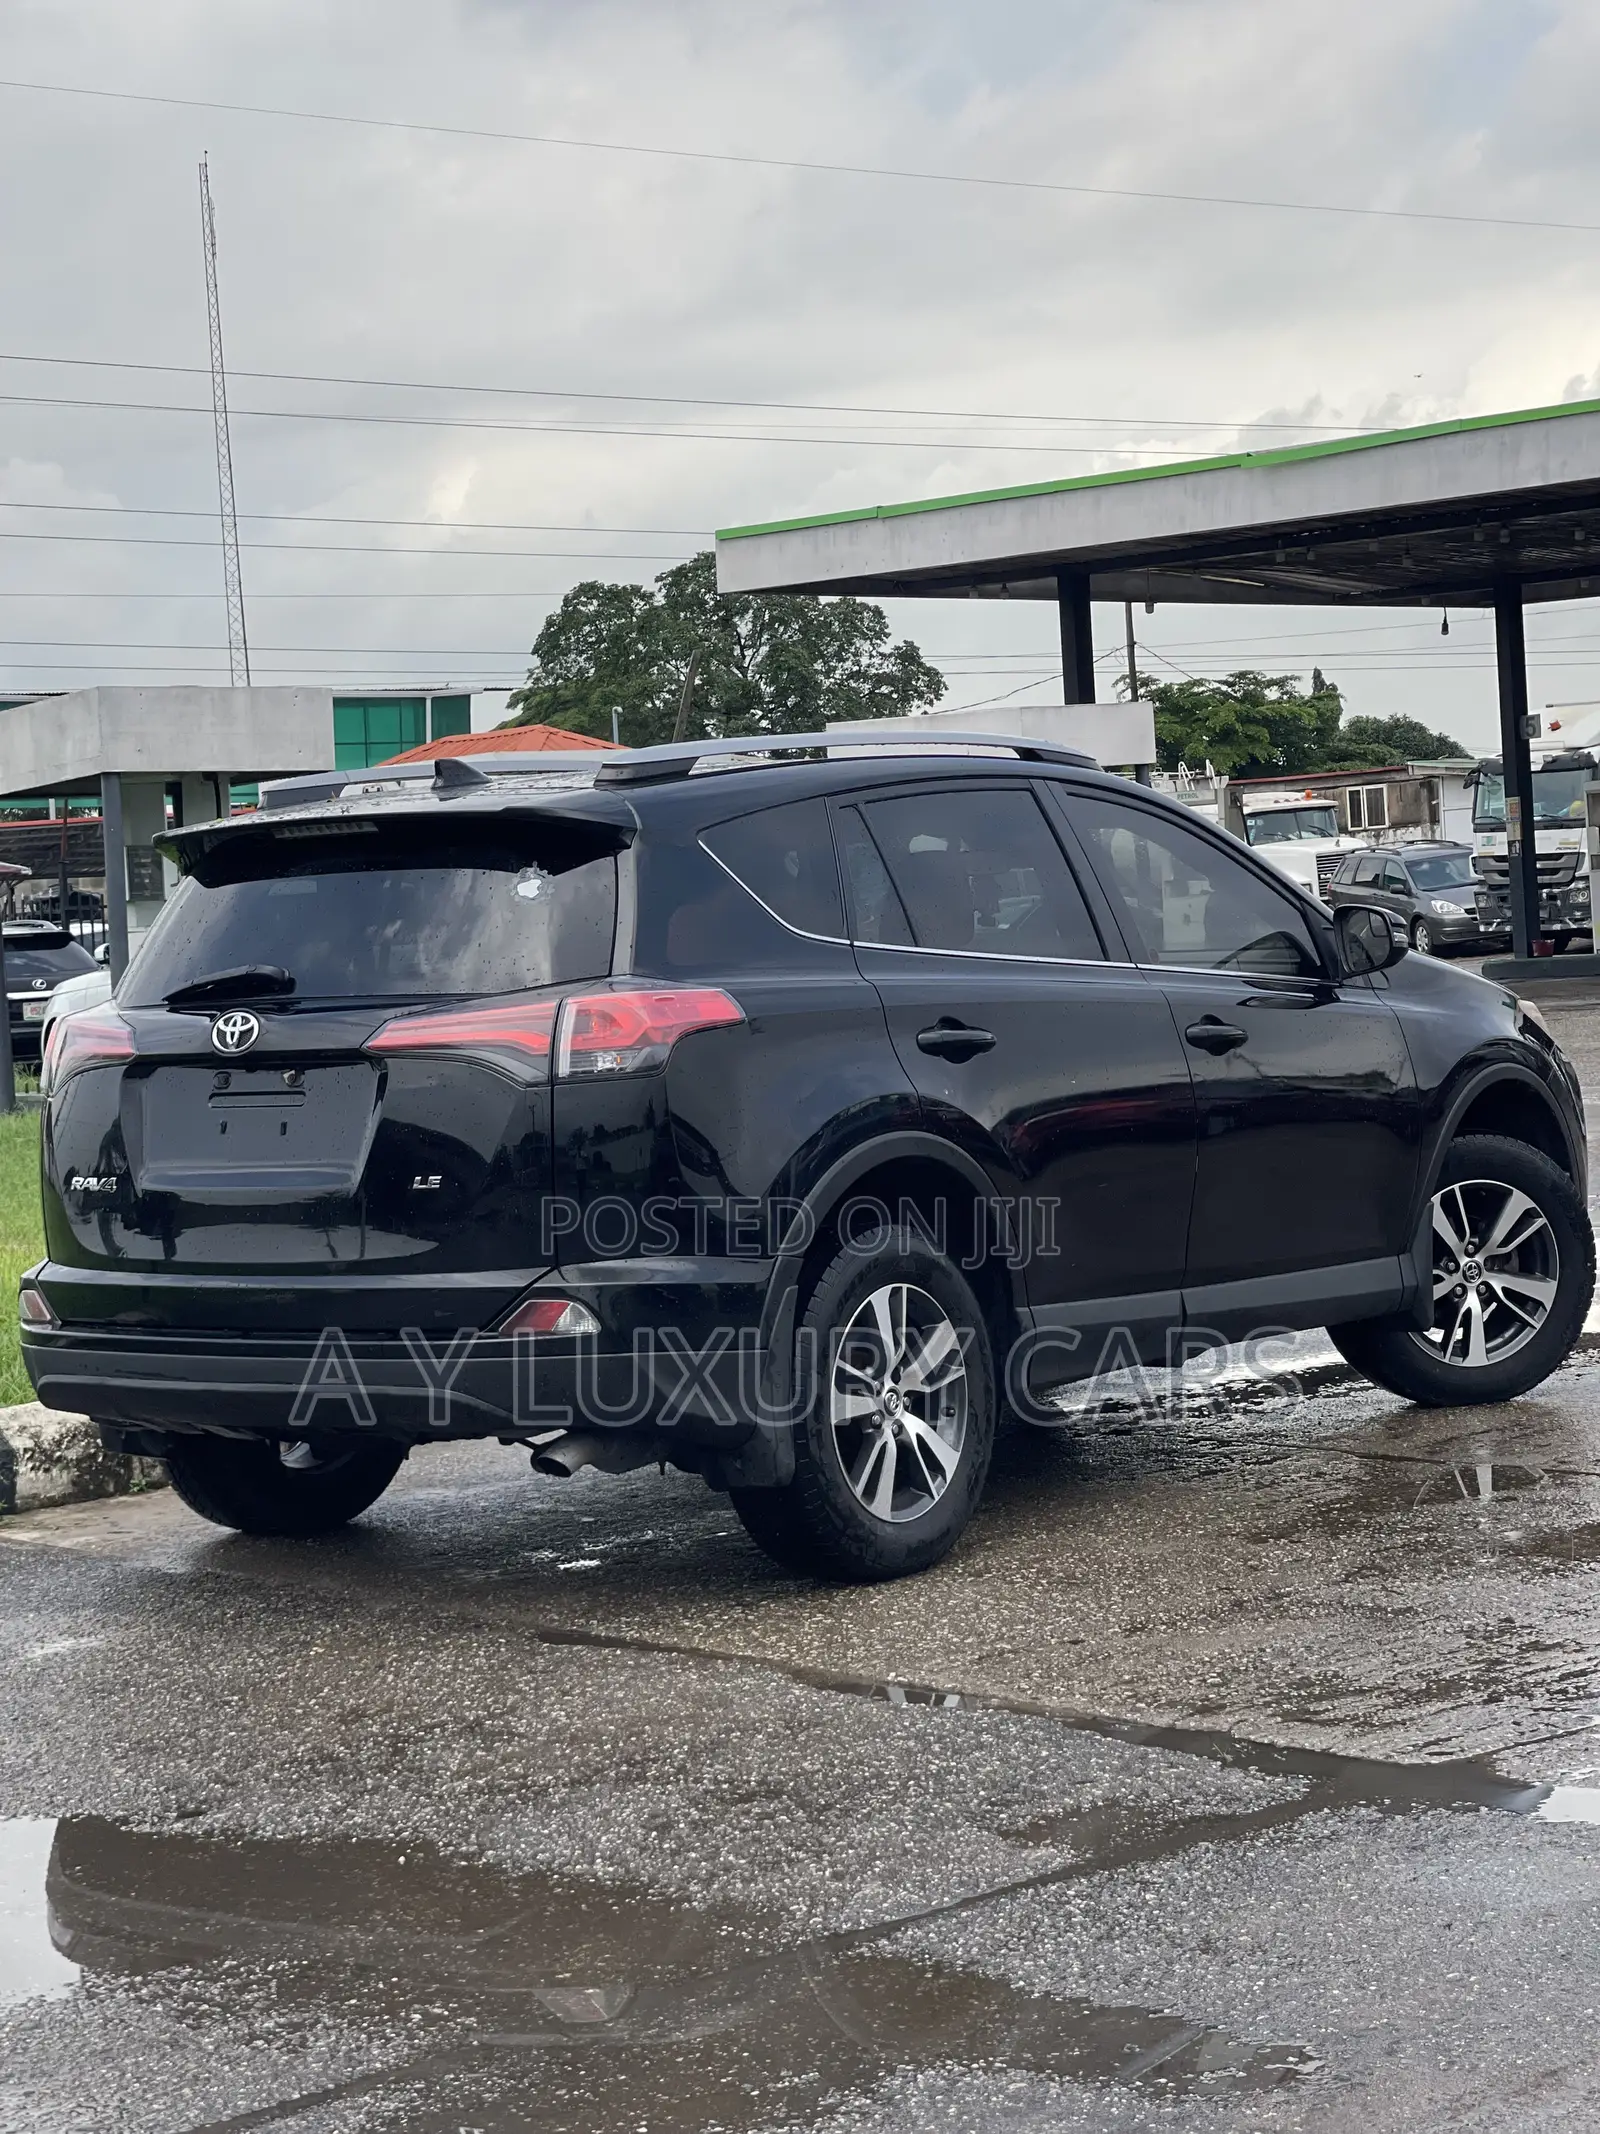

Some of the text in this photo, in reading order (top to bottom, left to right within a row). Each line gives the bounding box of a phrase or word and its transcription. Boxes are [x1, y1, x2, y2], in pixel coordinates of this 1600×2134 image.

[1525, 716, 1537, 737] 5
[1177, 792, 1199, 800] PETROL
[70, 1176, 117, 1193] RAV4
[412, 1175, 442, 1189] LE
